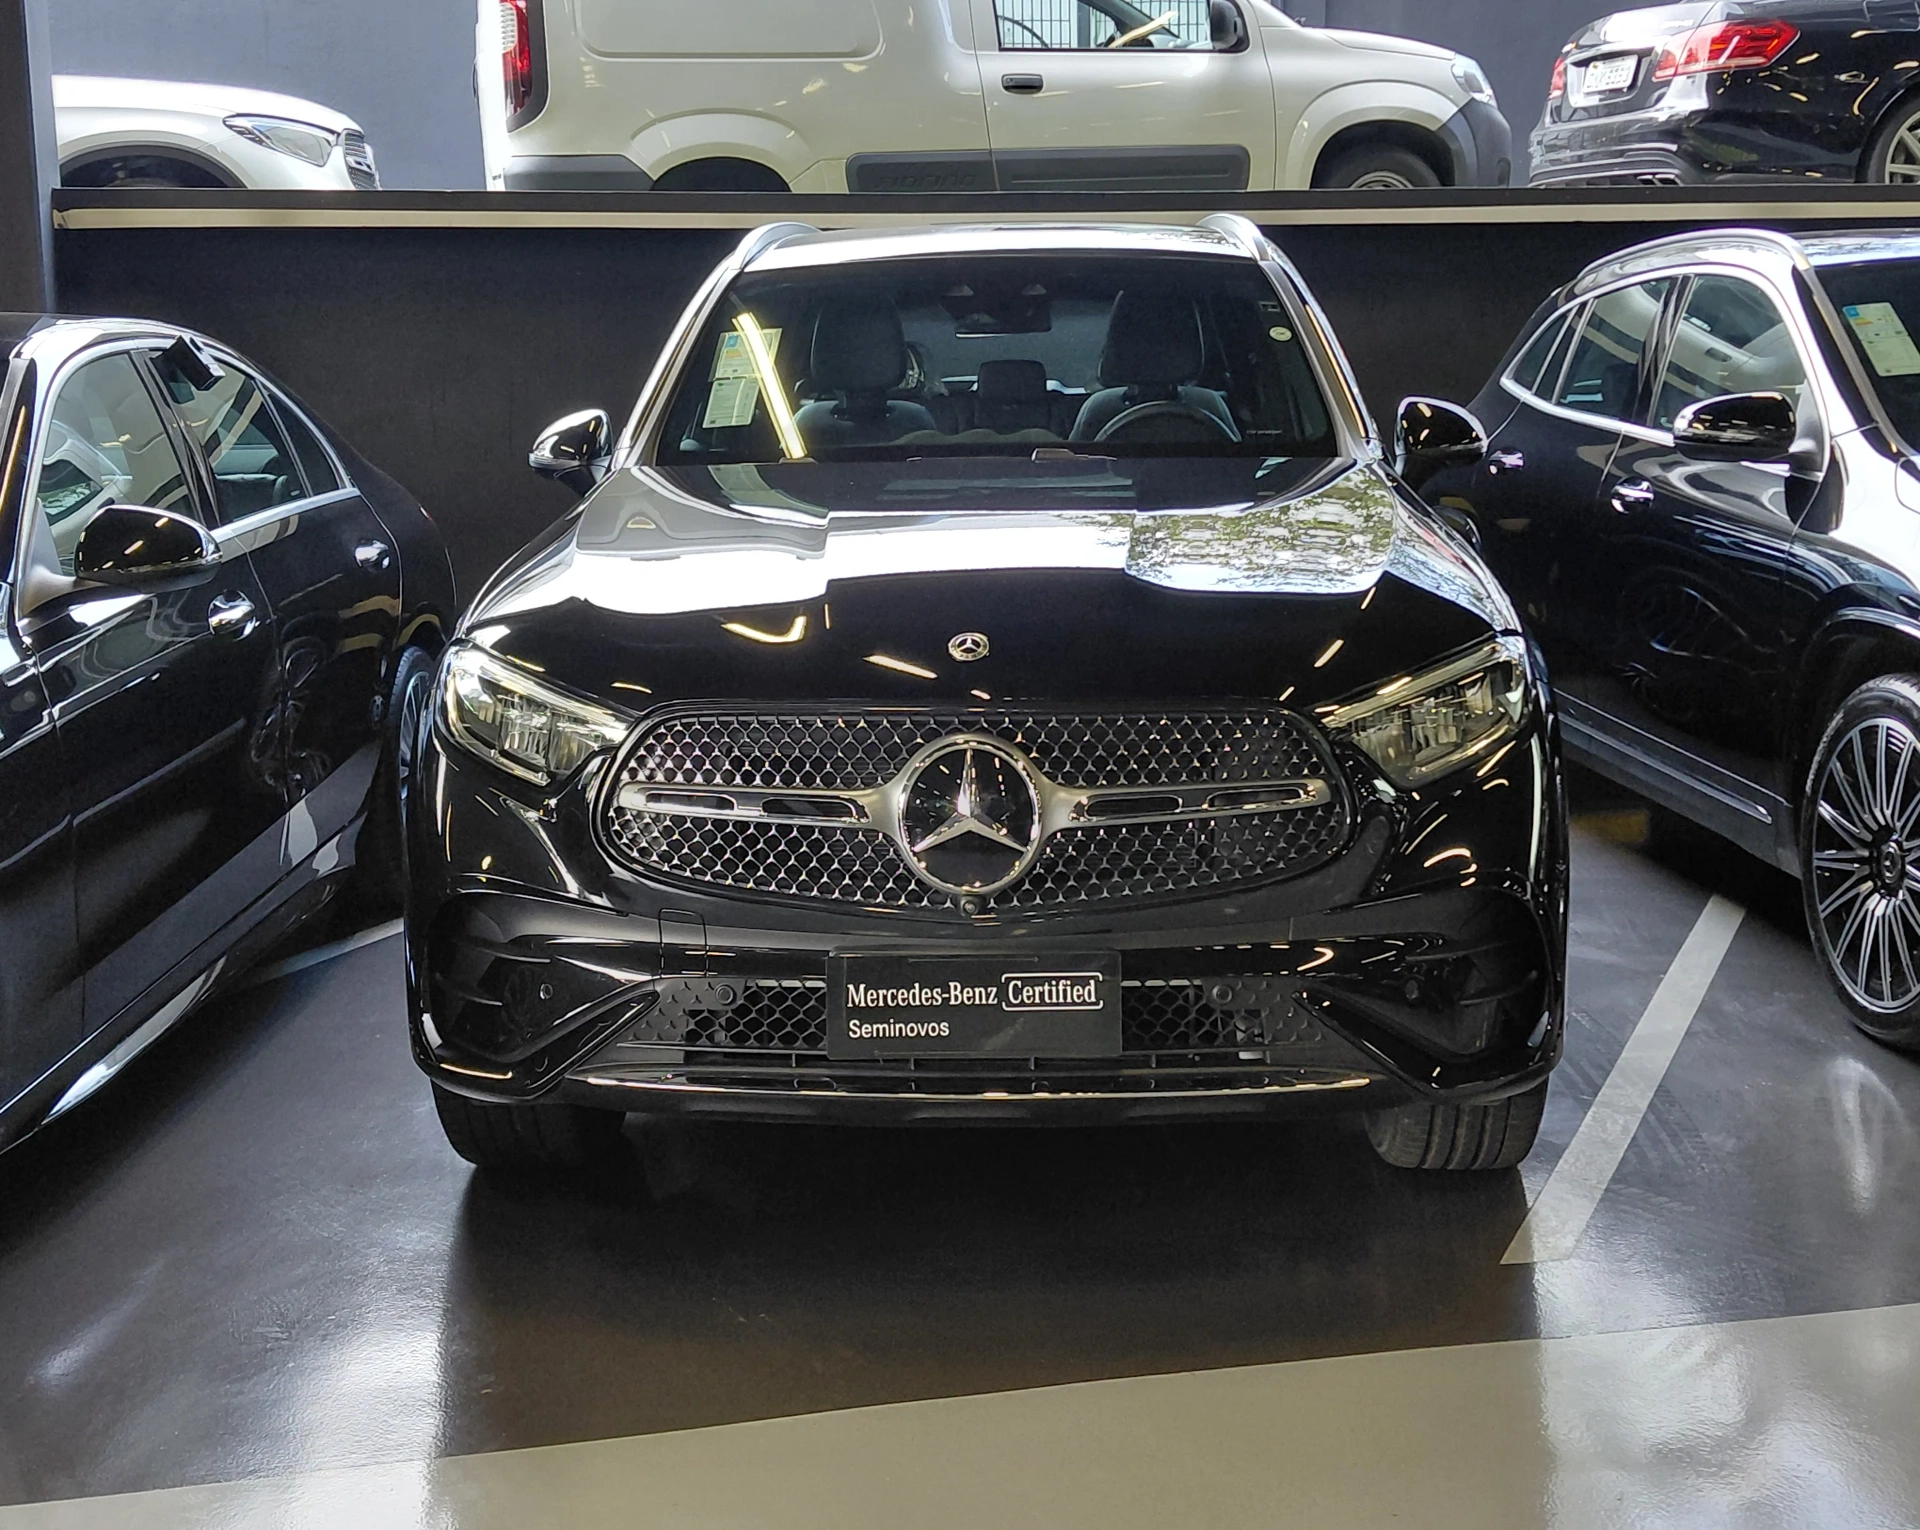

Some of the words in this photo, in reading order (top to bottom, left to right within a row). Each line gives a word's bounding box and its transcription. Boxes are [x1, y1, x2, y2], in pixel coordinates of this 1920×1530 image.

[847, 981, 997, 1007] Mercedes-Benz
[1007, 979, 1097, 1004] Certified
[848, 1018, 950, 1038] Seminovos
